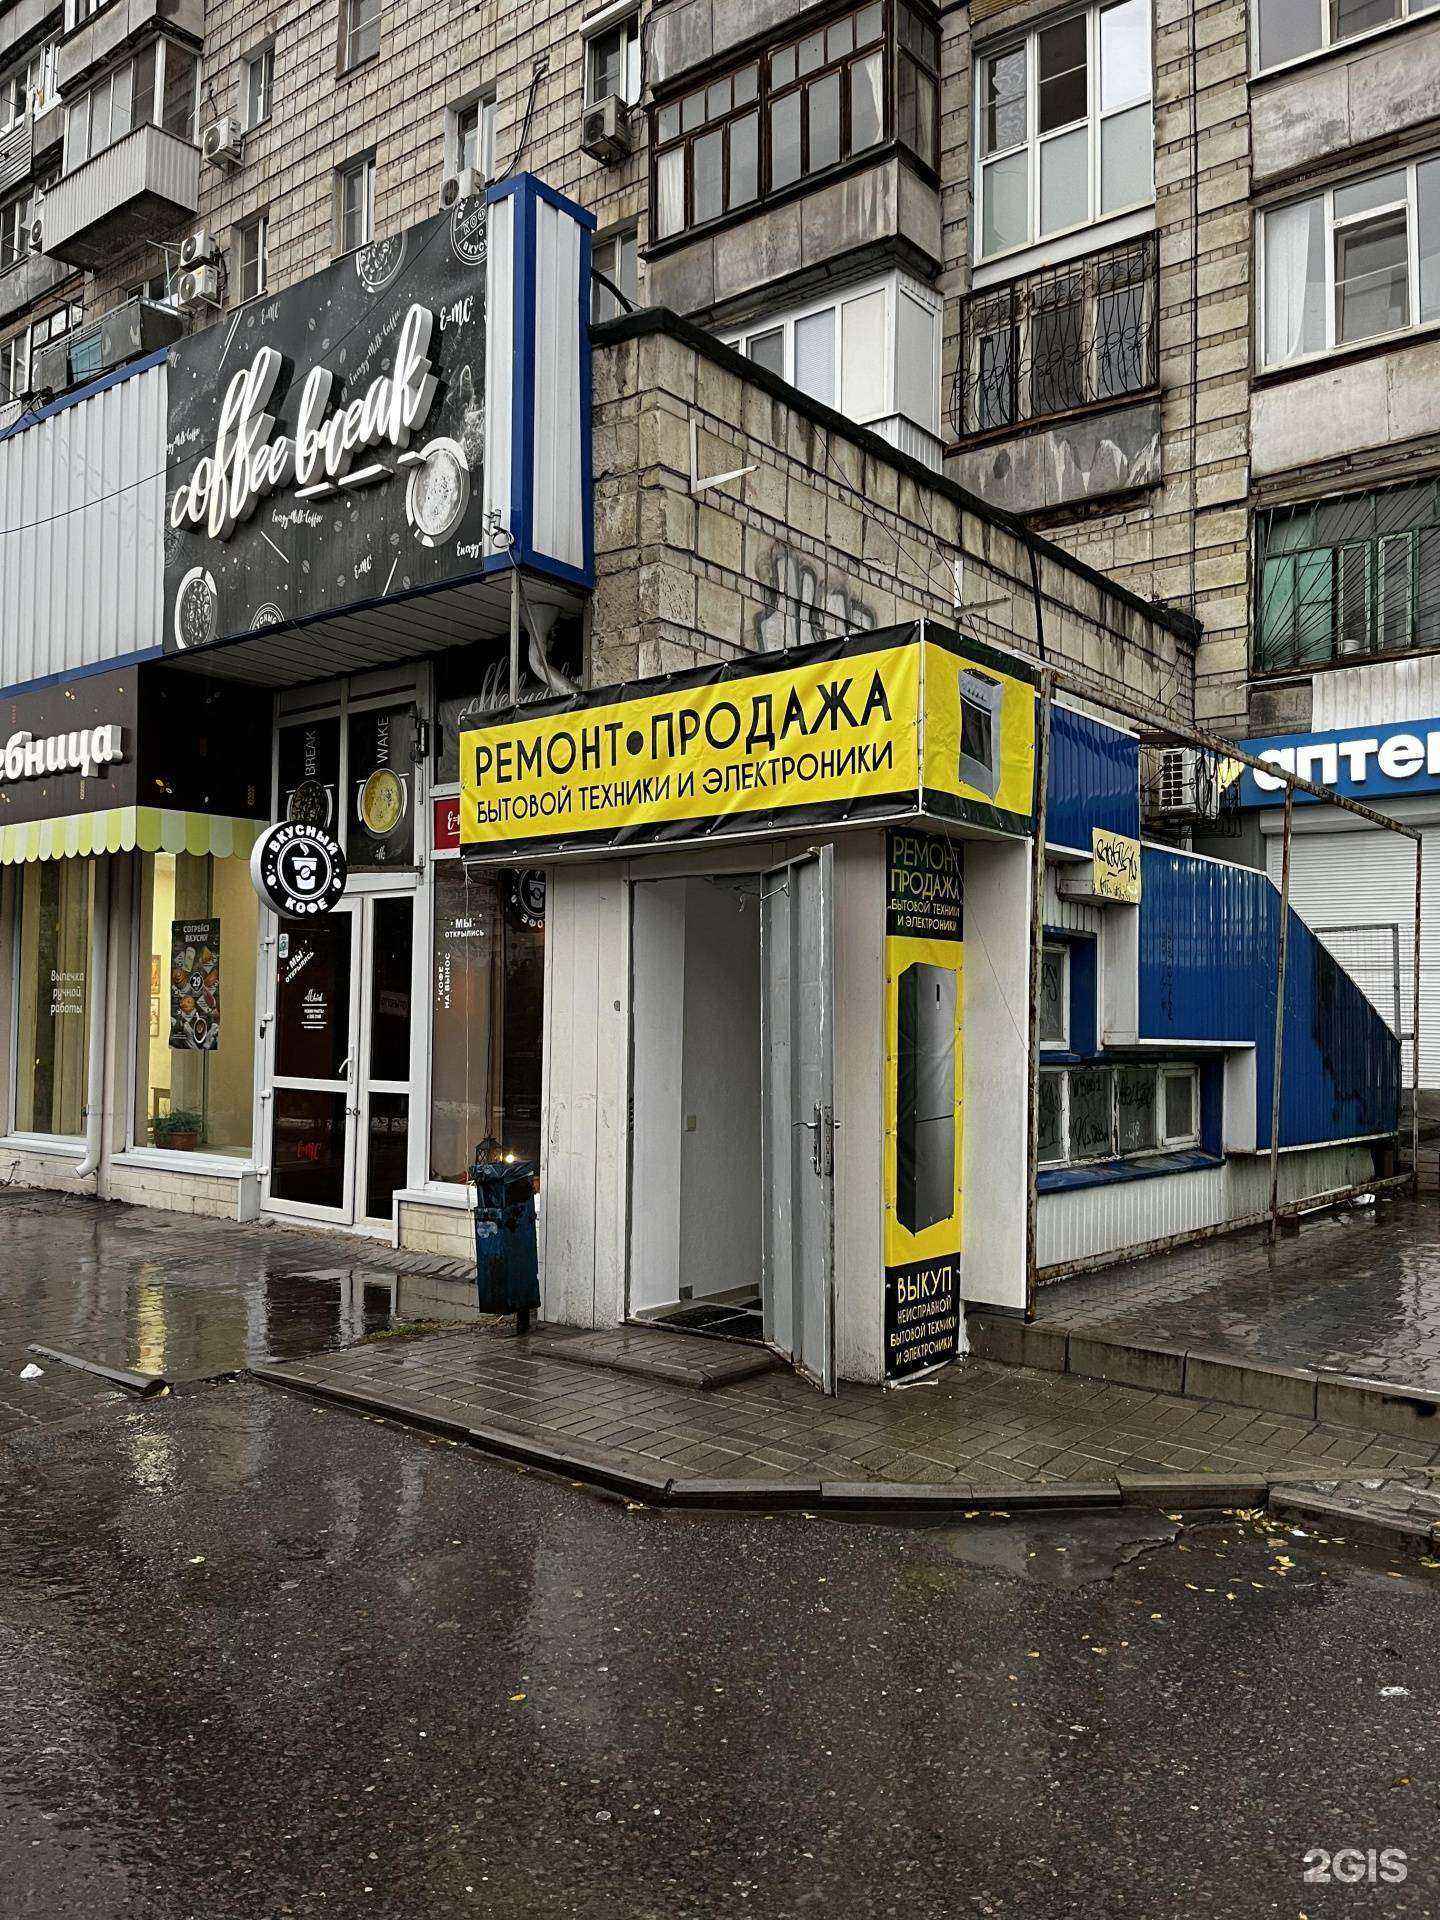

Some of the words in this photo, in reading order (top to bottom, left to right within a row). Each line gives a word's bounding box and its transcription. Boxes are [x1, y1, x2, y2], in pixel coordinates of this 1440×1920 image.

[171, 346, 294, 539] coffee
[295, 303, 436, 486] break
[376, 715, 390, 765] WAKE
[475, 721, 624, 787] РЕМОНТ
[651, 668, 893, 761] ПРОДАЖА
[304, 730, 317, 777] BREAK
[477, 784, 572, 824] БЫТОВОЙ
[578, 774, 670, 812] ТЕХНИКИ
[678, 770, 695, 799] И
[702, 740, 894, 796] ЭЛЕКТРОНИКИ
[268, 824, 339, 856] ВКУСНЫЙ
[893, 835, 960, 873] РЕМОНТ
[891, 868, 961, 901] ПРОДАЖА
[285, 896, 329, 914] КОФЕ
[891, 898, 931, 913] БЫТОВОЙ
[932, 902, 960, 918] ТЕХНИКИ
[444, 929, 485, 938] ОТКРЫЛИСЬ
[454, 918, 474, 929] МЫ
[897, 914, 904, 927] И
[905, 915, 958, 932] ЭЛЕКТРОНИКИ
[289, 950, 304, 969] МЫ
[51, 970, 84, 981] Выпечка
[50, 1002, 83, 1016] работы
[53, 986, 81, 1001] ручной
[444, 994, 450, 1008] НА
[897, 1265, 952, 1304] ВЫКУП
[897, 1294, 953, 1325] НЕИСПРАВНОЙ
[890, 1322, 927, 1348] БЫТОВОЙ
[927, 1316, 958, 1336] ТЕХНИКИ
[895, 1351, 902, 1366] И
[903, 1335, 953, 1364] ЭЛЕКТРОНИКИ
